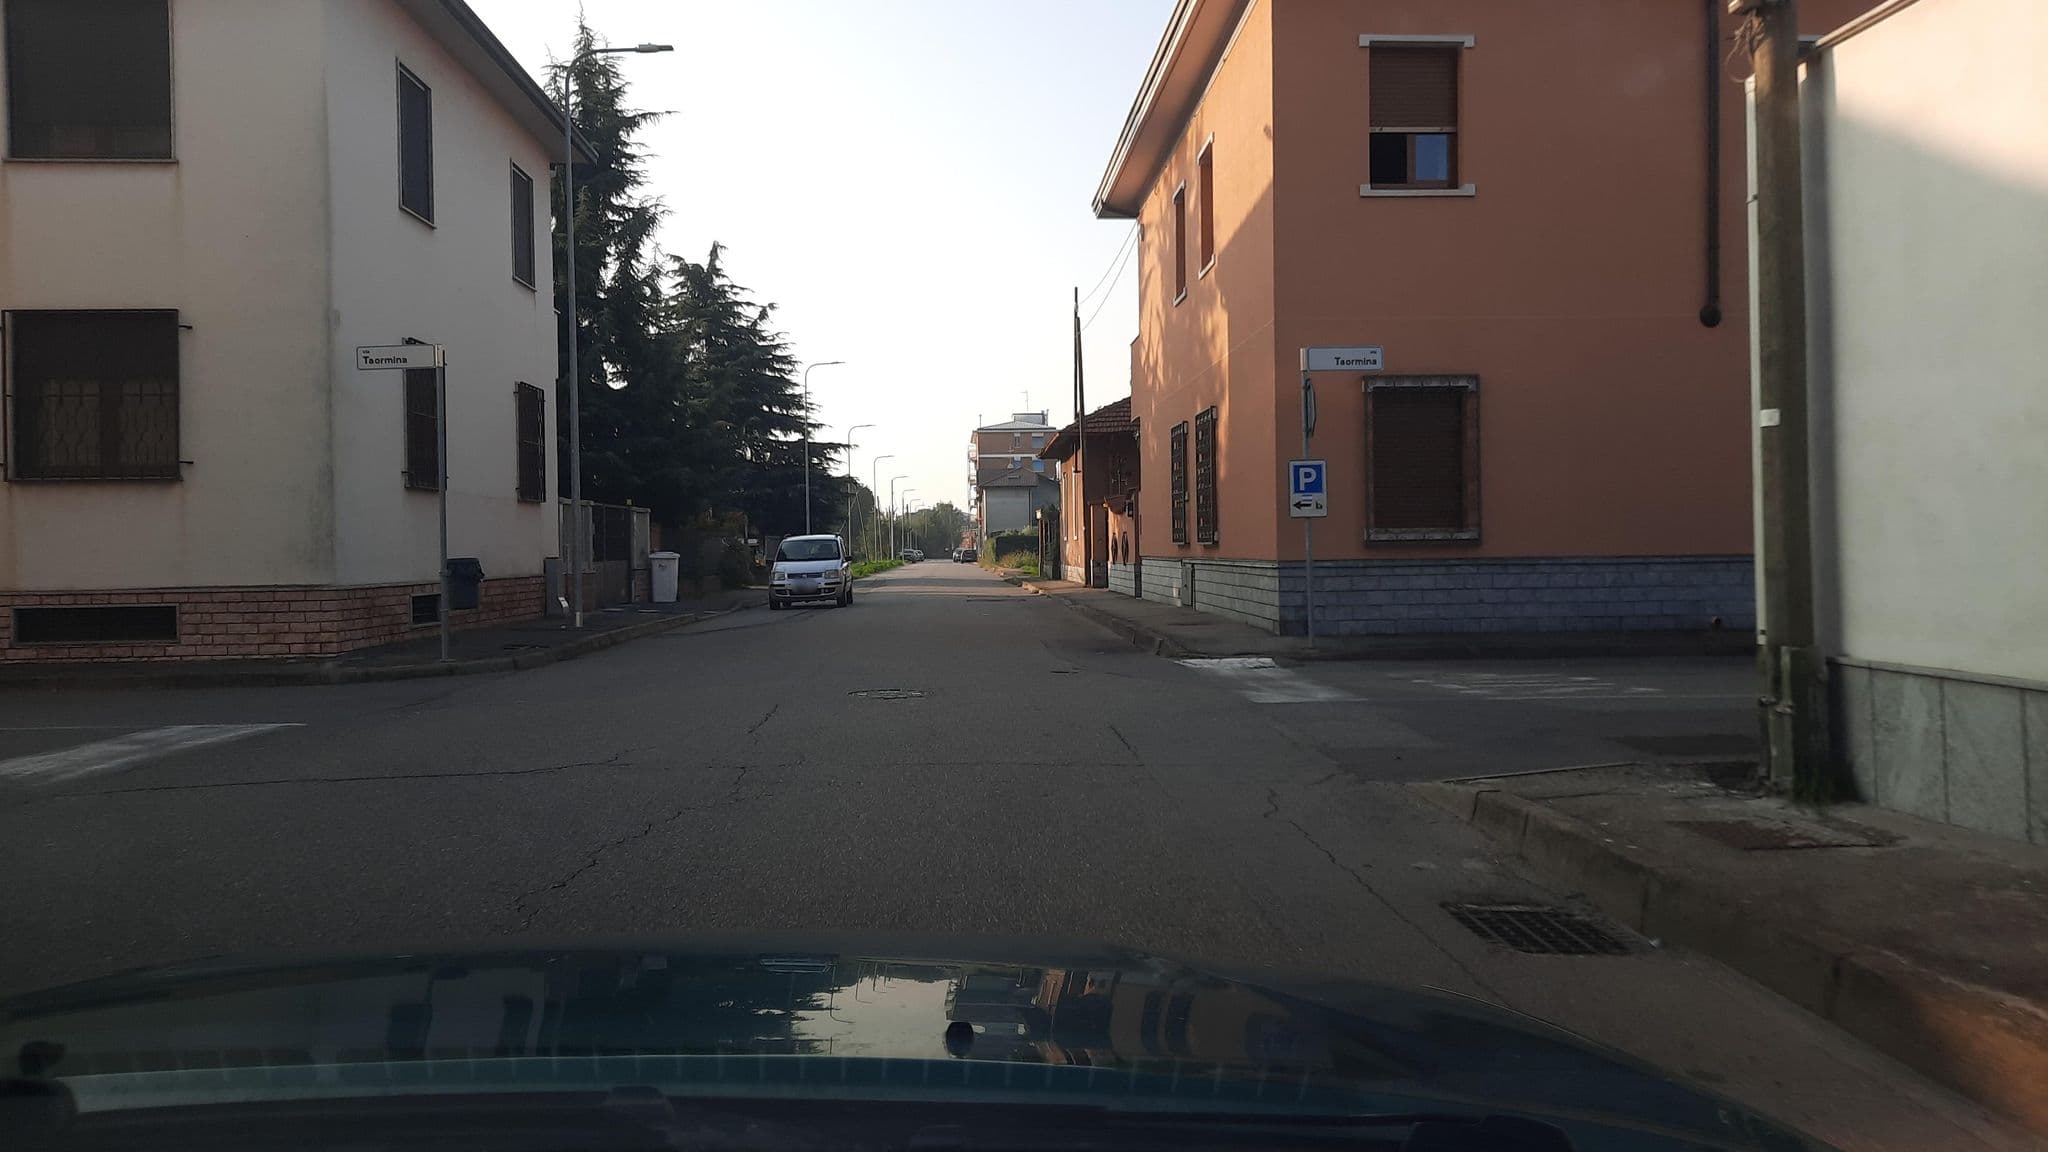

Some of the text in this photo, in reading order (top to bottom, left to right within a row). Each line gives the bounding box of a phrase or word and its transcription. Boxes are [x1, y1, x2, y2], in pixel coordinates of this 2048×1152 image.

[362, 356, 408, 364] Taormina
[1334, 356, 1377, 366] Taormina
[1299, 467, 1317, 491] P
